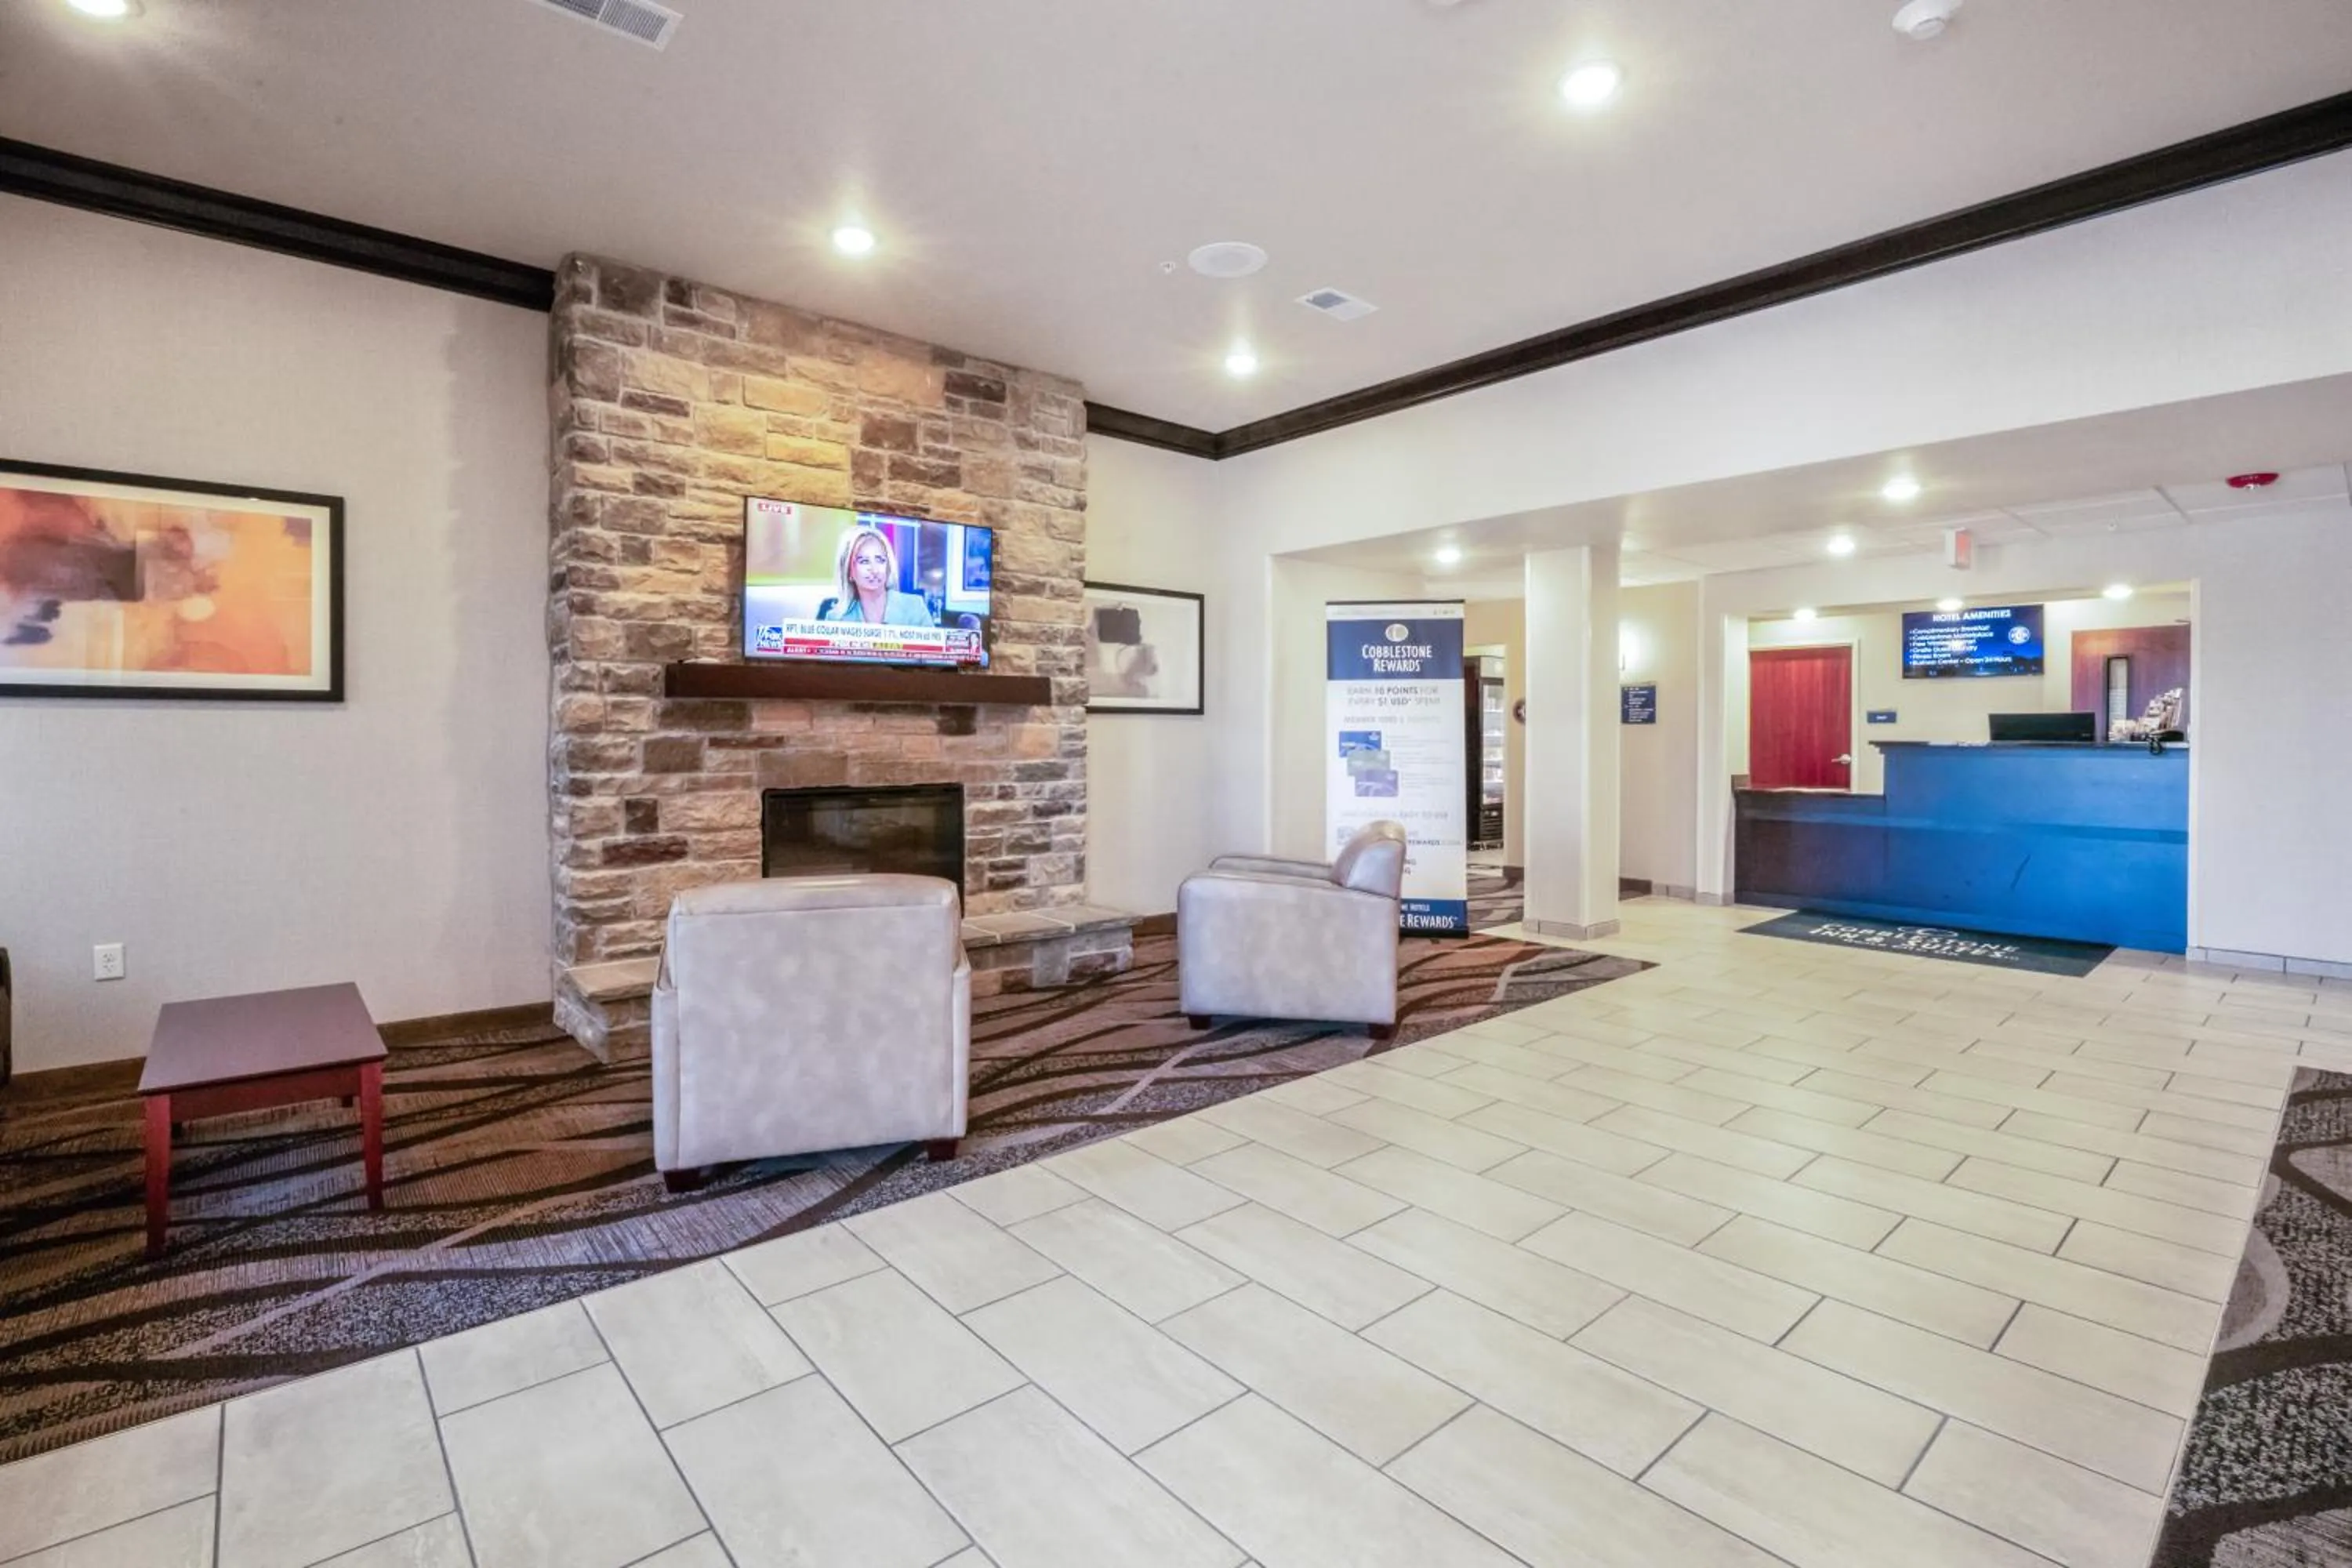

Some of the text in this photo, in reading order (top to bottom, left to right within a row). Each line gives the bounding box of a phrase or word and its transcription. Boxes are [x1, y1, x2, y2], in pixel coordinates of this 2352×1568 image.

[1962, 609, 2011, 620] AMENITIES
[1362, 644, 1433, 659] COBBLESTONE
[1374, 659, 1421, 673] REWARDS
[1374, 686, 1385, 695] 10
[1387, 686, 1417, 695] POINTS
[1407, 913, 1454, 928] REWARDS
[1809, 927, 1860, 939] INN
[1905, 939, 2009, 959] SUITES
[1820, 924, 2020, 953] COBBLESTONE
